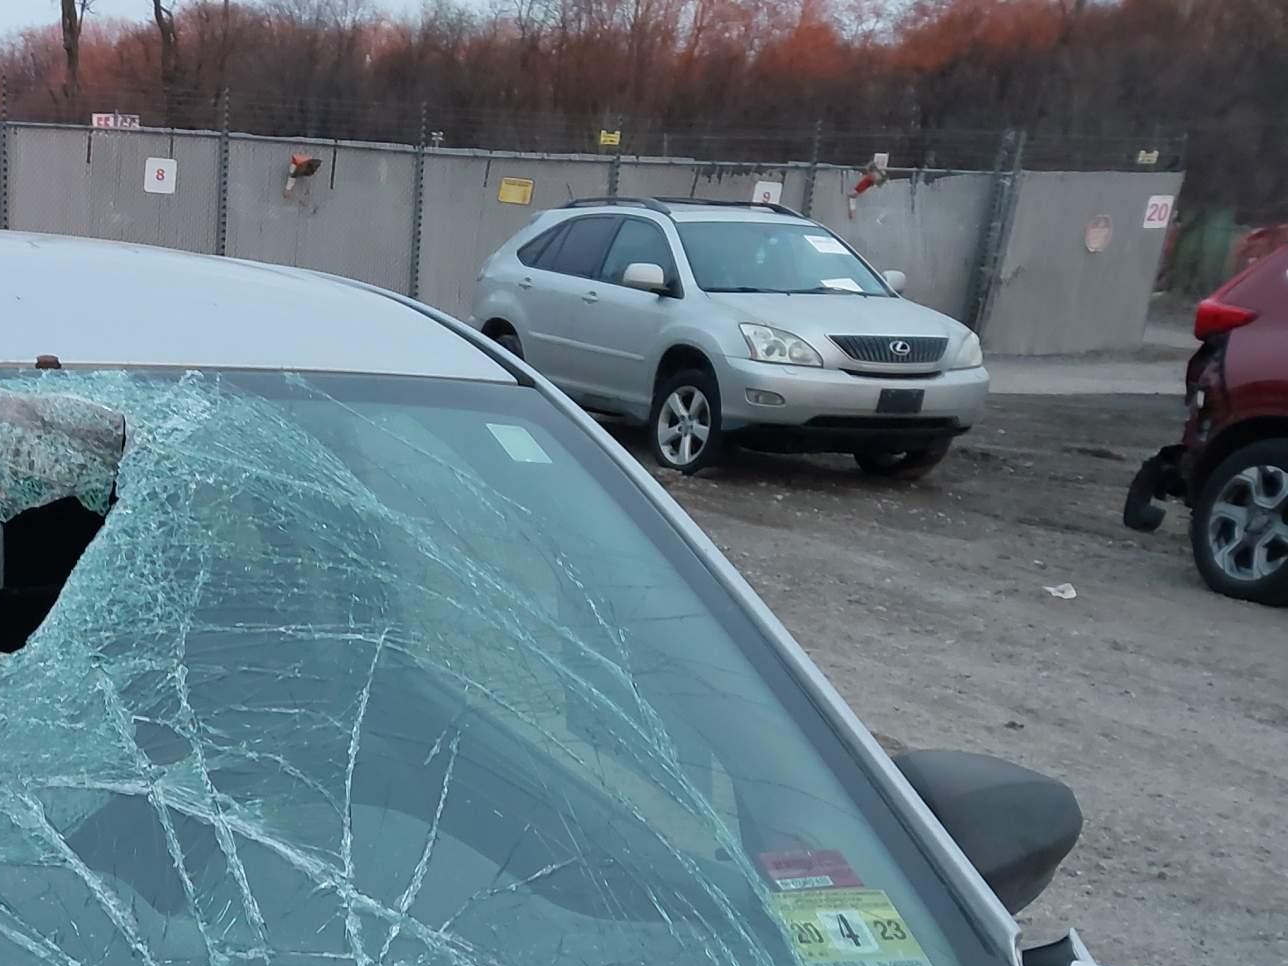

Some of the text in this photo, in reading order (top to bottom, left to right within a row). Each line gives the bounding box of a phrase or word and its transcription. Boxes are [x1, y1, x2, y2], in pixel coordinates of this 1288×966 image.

[155, 168, 165, 181] 8
[763, 191, 771, 203] 9
[1146, 203, 1169, 222] 20
[790, 913, 907, 947] 20 4 23
